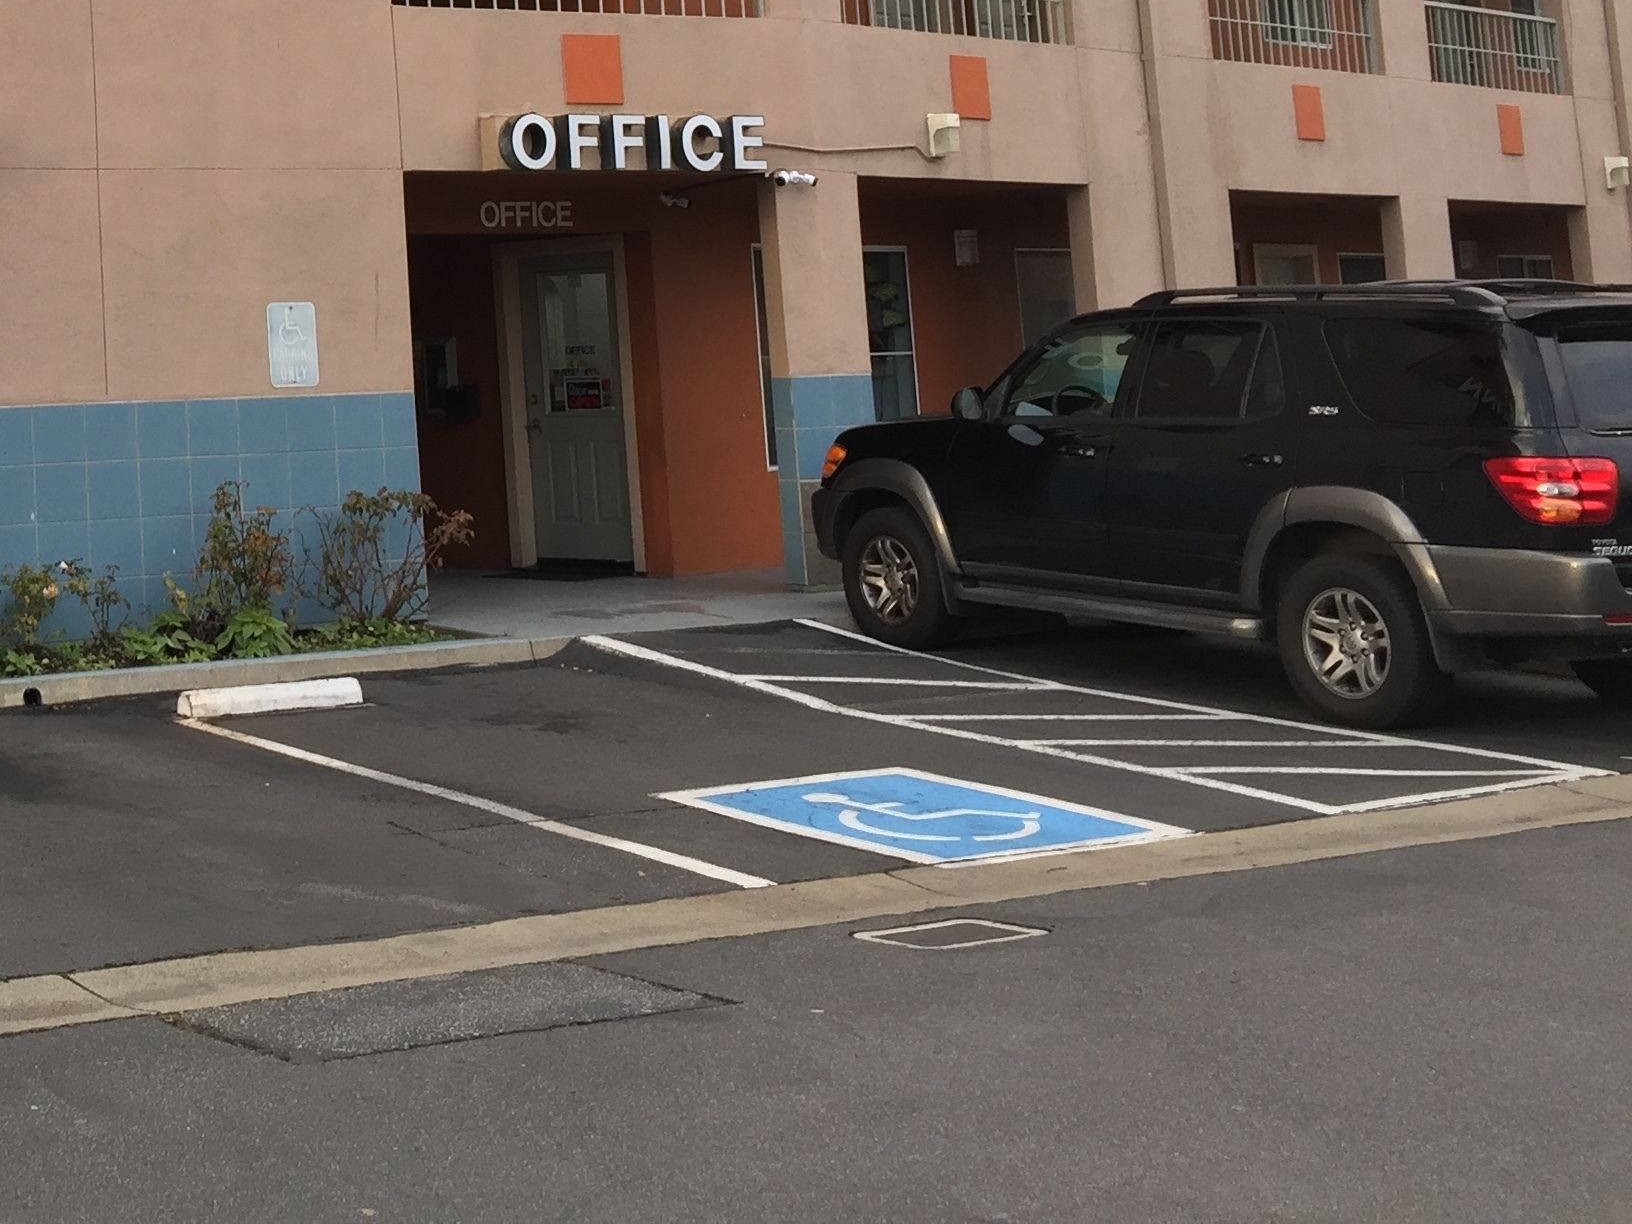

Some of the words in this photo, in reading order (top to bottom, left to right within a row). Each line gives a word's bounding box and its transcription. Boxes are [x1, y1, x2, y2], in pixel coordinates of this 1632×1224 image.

[509, 112, 768, 172] OFFICE
[480, 200, 574, 227] OFFICE
[280, 366, 308, 382] ONLY
